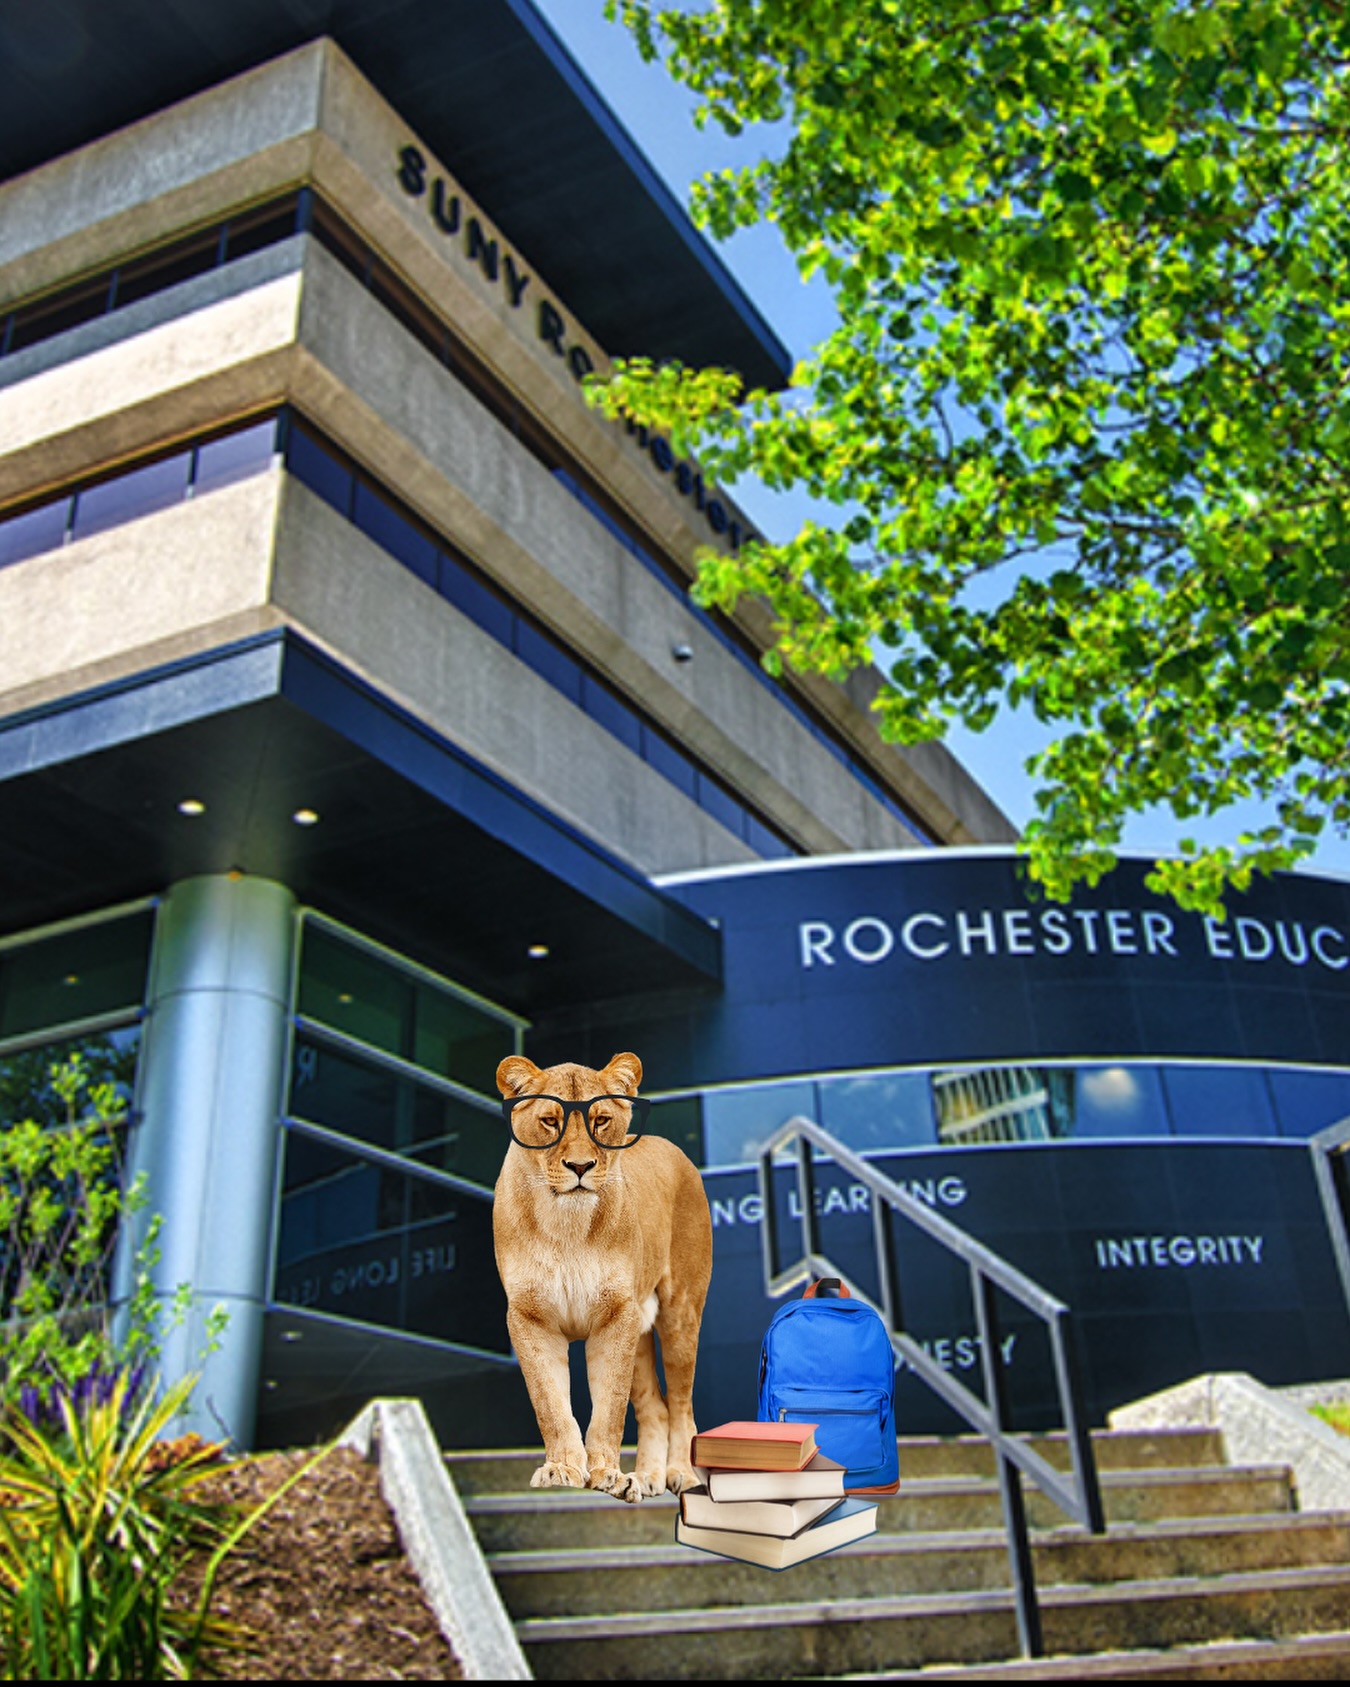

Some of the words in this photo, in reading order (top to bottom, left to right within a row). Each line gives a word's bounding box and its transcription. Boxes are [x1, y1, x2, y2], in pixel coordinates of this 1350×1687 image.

[398, 145, 530, 308] SUNY
[800, 908, 1178, 968] ROCHESTER
[1203, 915, 1350, 970] EDUC
[1096, 1236, 1263, 1268] INTEGRITY
